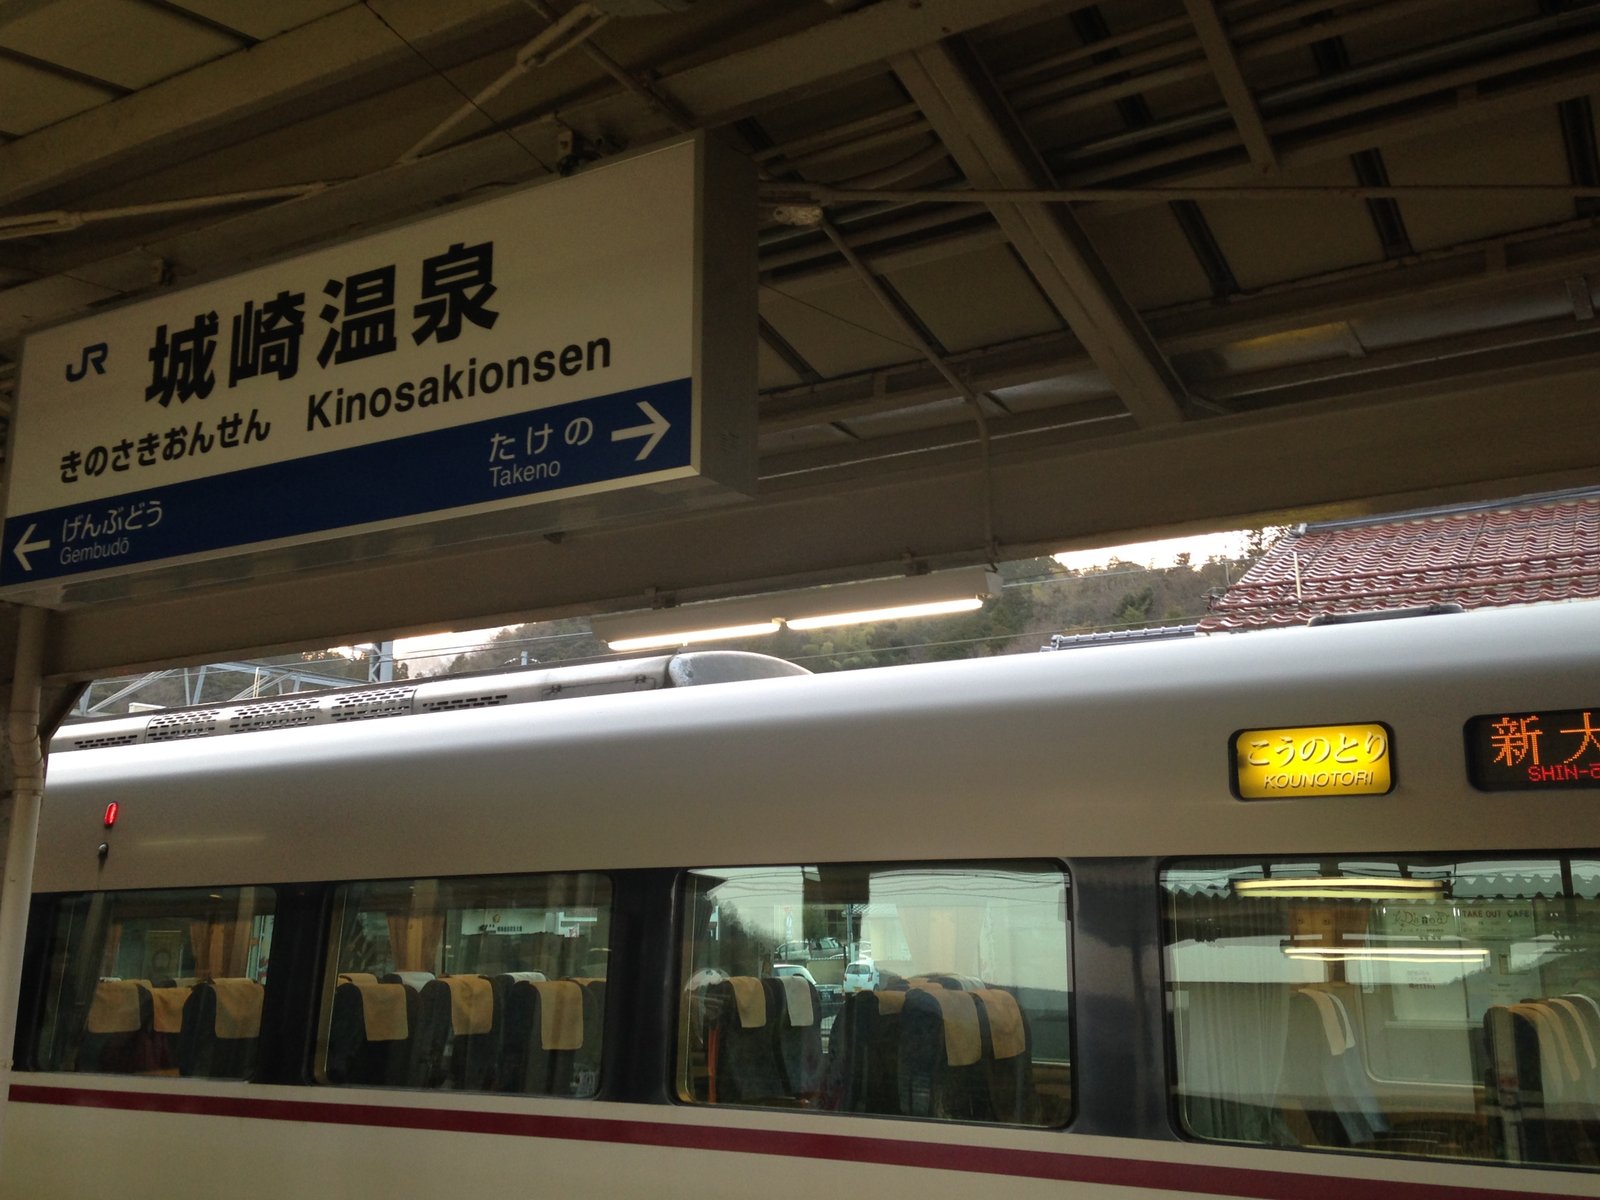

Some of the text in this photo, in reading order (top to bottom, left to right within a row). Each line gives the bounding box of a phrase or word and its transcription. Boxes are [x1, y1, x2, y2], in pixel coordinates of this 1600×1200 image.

[145, 241, 500, 408] 城崎温泉
[66, 342, 108, 382] JR
[307, 337, 610, 431] Kinosakionsen
[60, 409, 271, 483] きのさきおんせん
[489, 416, 594, 462] たけの
[489, 459, 562, 488] Takeno
[61, 499, 163, 543] げんぶどう
[1248, 732, 1387, 768] こうのとり
[1264, 771, 1374, 789] KOUNOTORI
[1463, 910, 1483, 919] TAKE
